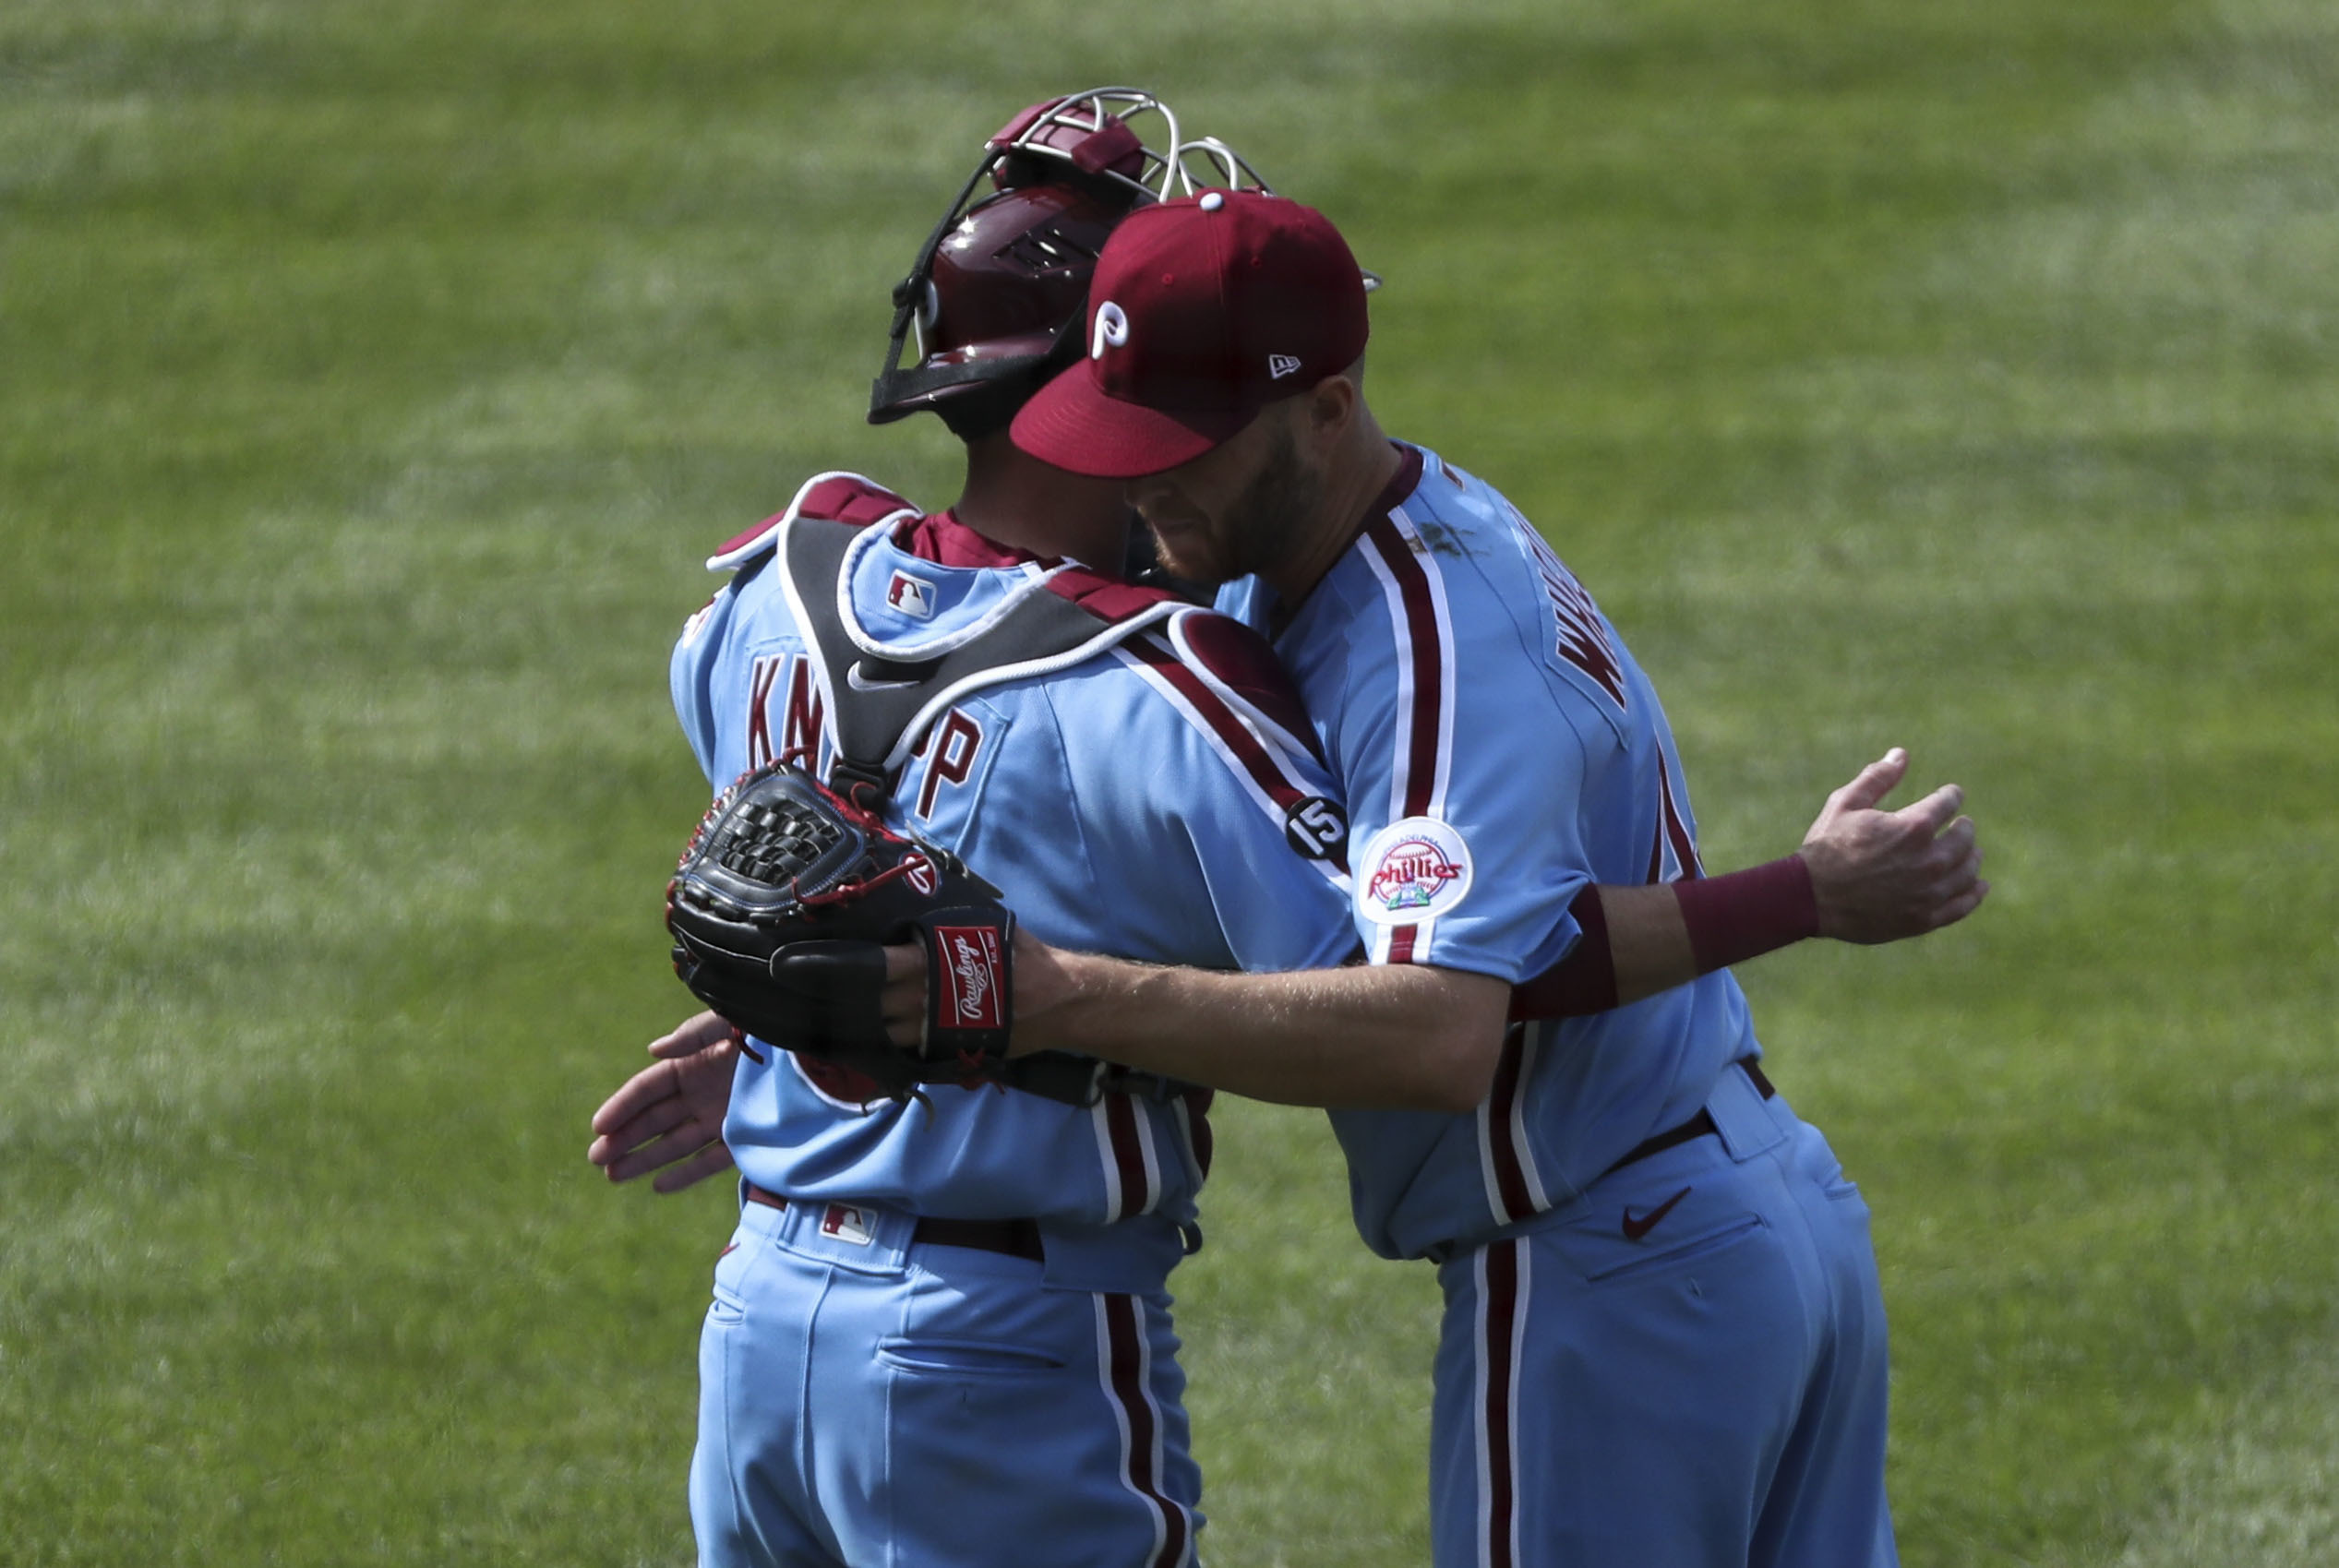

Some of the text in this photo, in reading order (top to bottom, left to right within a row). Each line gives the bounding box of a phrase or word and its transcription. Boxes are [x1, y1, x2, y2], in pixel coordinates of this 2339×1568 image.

[746, 651, 984, 823] KNP
[1289, 798, 1345, 856] 15
[954, 934, 984, 1020] Rawlings
